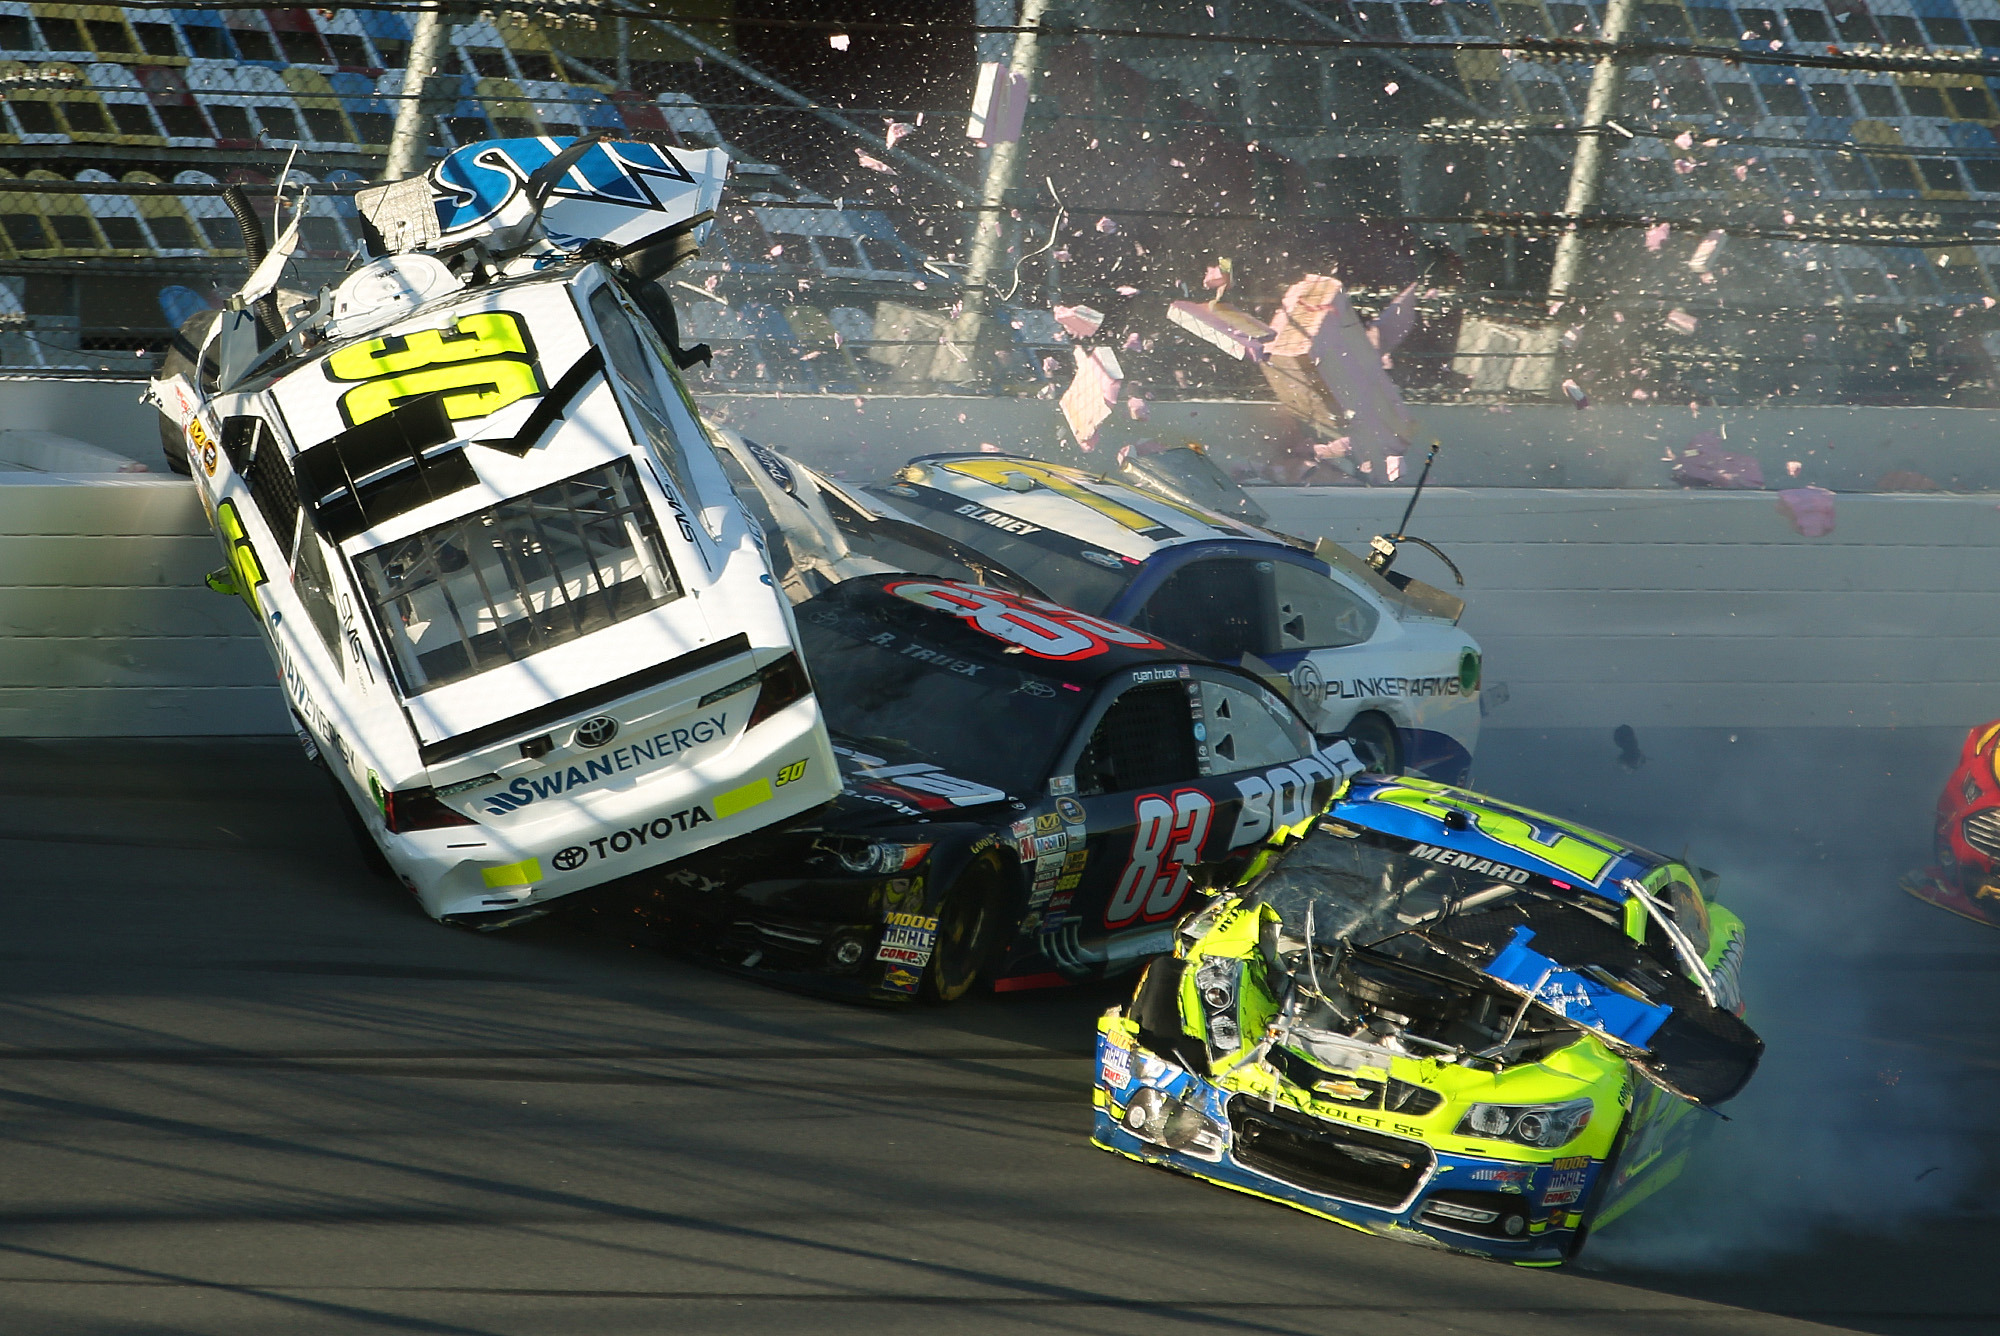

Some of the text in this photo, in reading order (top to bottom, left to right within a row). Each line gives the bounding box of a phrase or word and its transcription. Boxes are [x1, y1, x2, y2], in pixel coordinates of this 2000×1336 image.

[954, 504, 1043, 536] BLANEY
[900, 643, 985, 677] TRUEX
[1132, 668, 1178, 684] ryan truex
[775, 757, 809, 788] 30
[589, 805, 713, 860] TOYOTA
[1104, 787, 1215, 929] 83
[1409, 843, 1531, 884] MENARD
[883, 911, 939, 931] MOOG
[880, 947, 918, 961] COMP
[884, 929, 937, 949] MAHLE
[1552, 1156, 1590, 1172] MOOG
